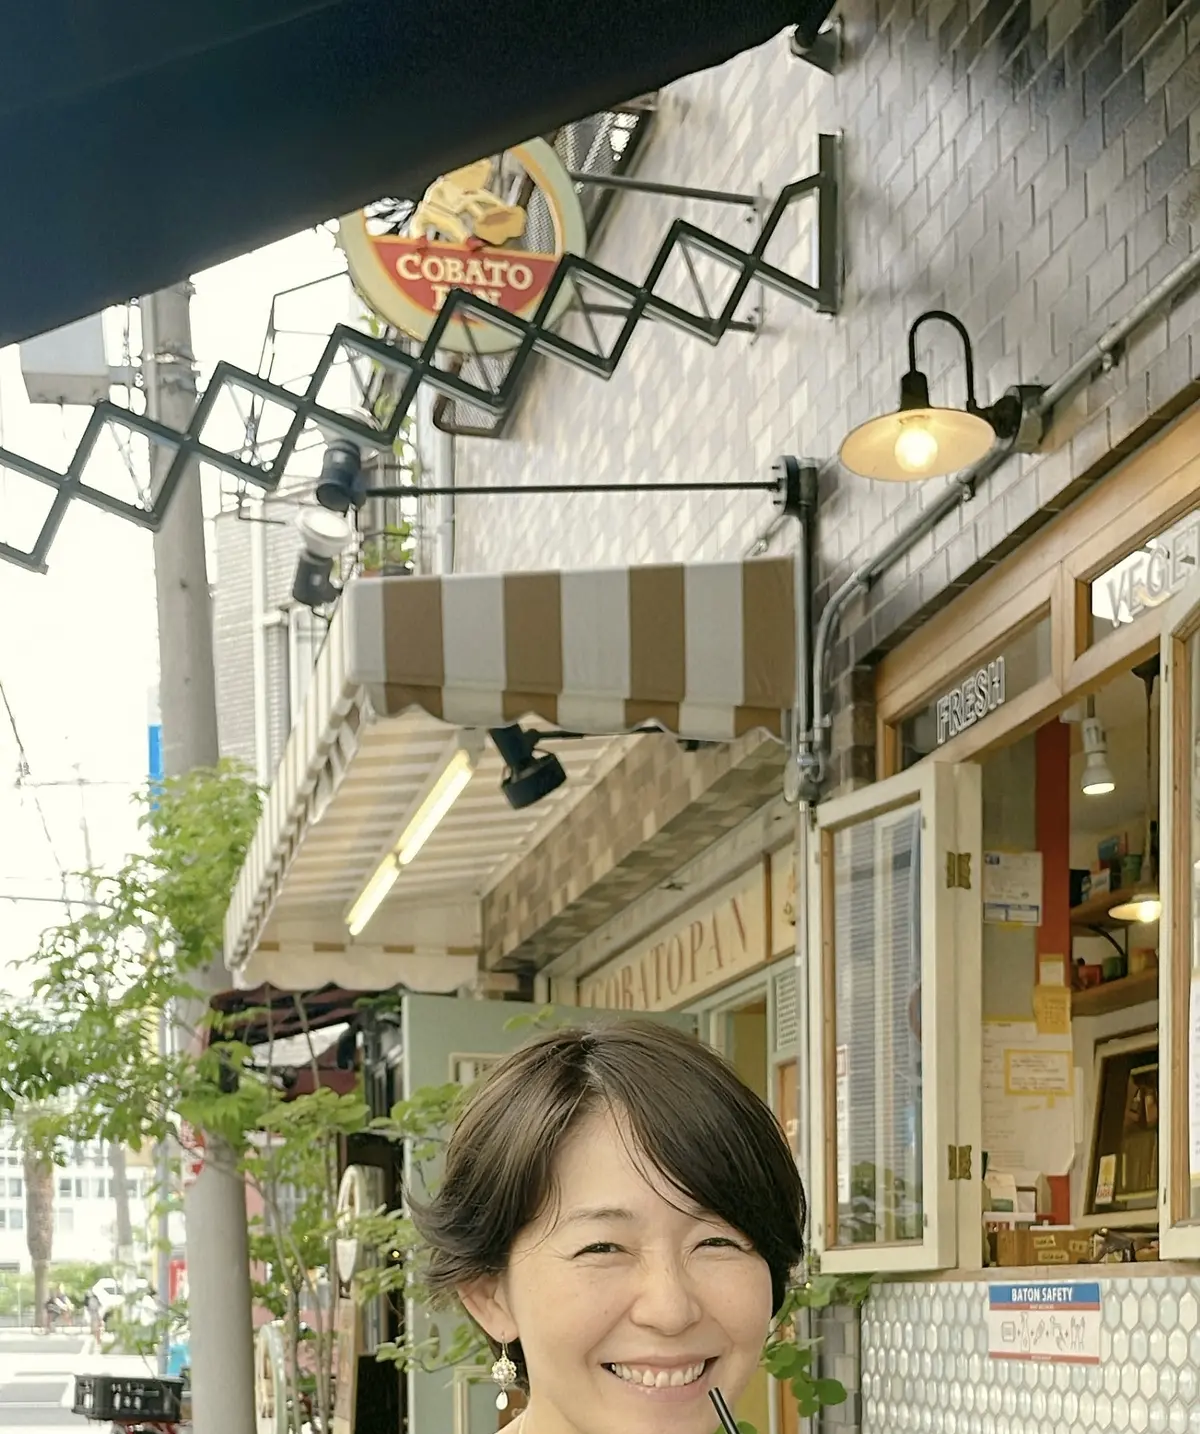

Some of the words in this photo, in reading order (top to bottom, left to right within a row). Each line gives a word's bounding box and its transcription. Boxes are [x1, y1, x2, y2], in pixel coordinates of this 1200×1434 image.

[395, 252, 534, 291] COBATO
[937, 656, 1005, 744] FRESH
[1011, 1288, 1040, 1302] BATON
[1042, 1287, 1073, 1302] SAFETY
